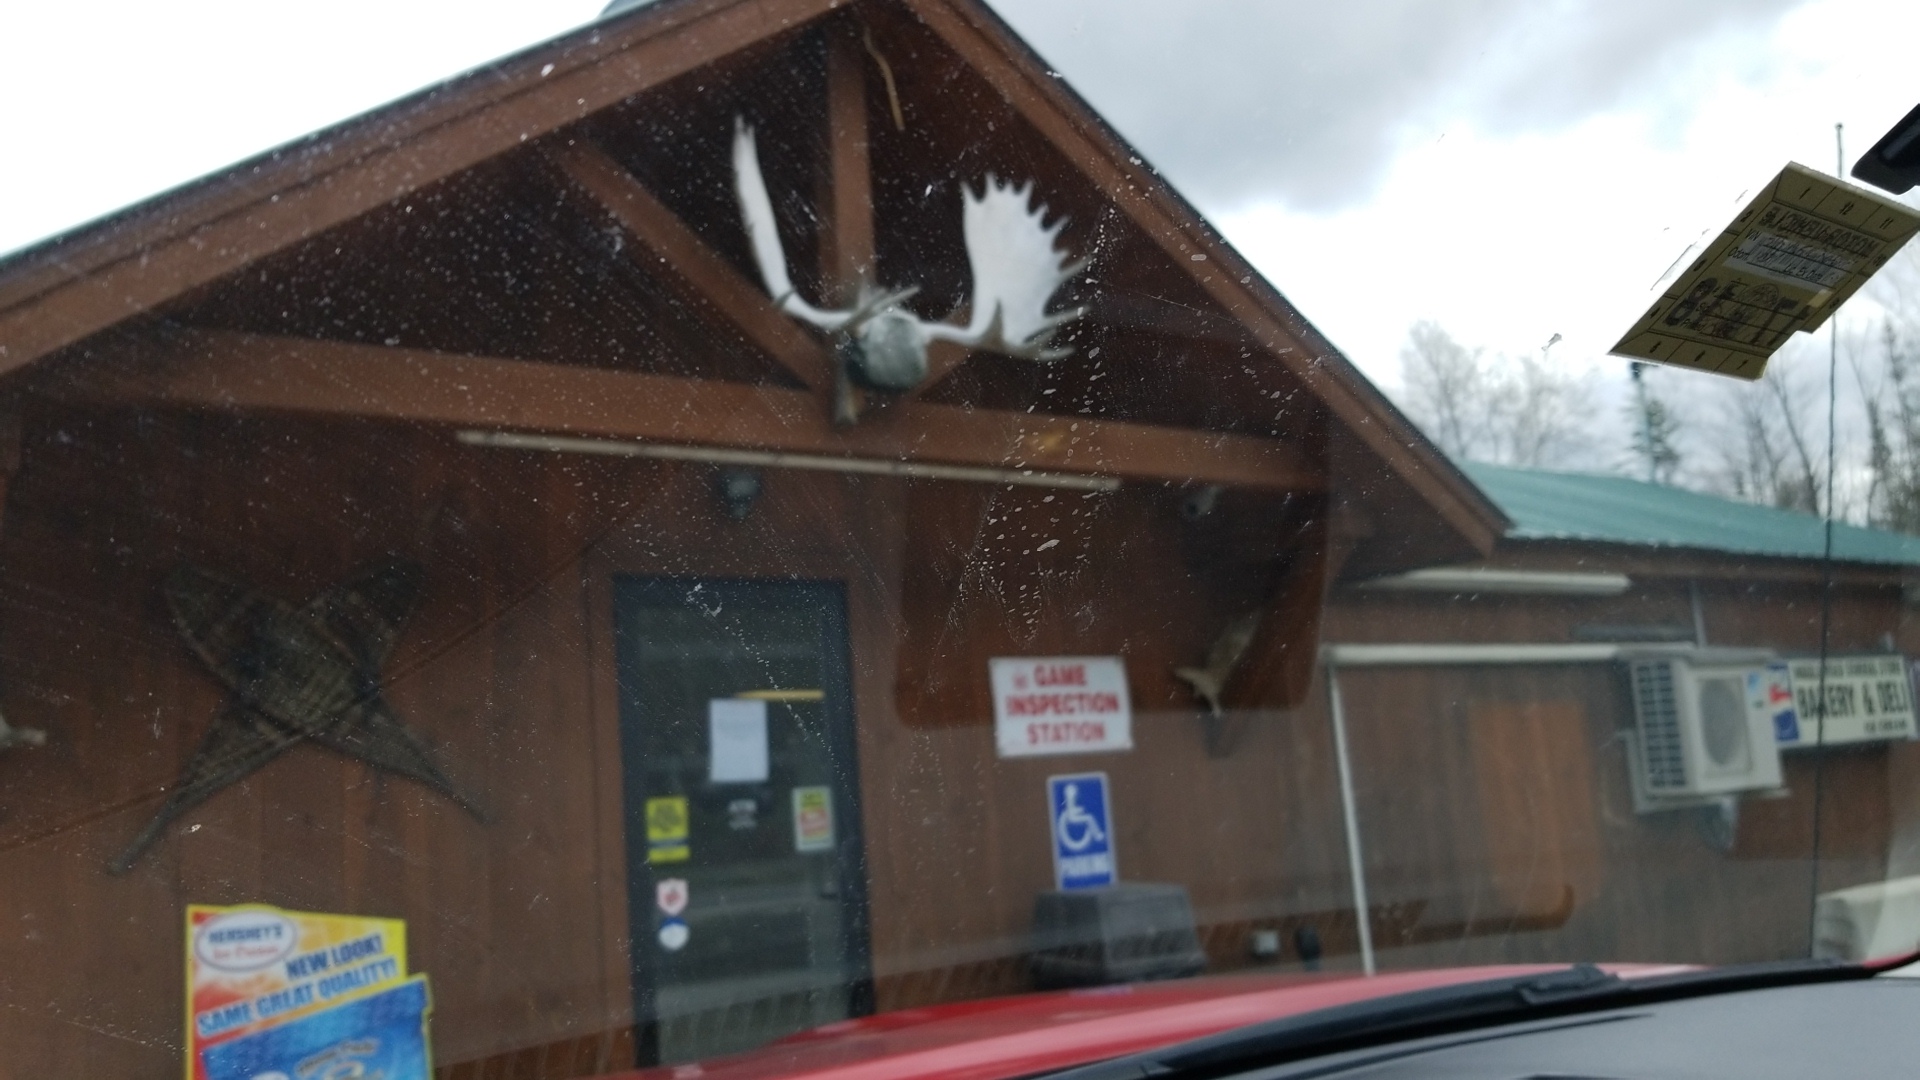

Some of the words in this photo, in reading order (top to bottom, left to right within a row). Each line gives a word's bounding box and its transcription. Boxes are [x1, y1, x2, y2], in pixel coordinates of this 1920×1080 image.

[1033, 664, 1088, 688] GAME
[1006, 691, 1120, 717] INSPECTION
[1797, 684, 1856, 721] BAKERY
[1862, 680, 1874, 715] &
[1876, 680, 1909, 714] DELI
[1027, 722, 1106, 745] STATION
[286, 952, 328, 980] NEW
[332, 934, 381, 965] LOOK!
[198, 1004, 250, 1035] SAME
[256, 982, 315, 1018] GREAT
[318, 956, 398, 1000] QUALITY!
